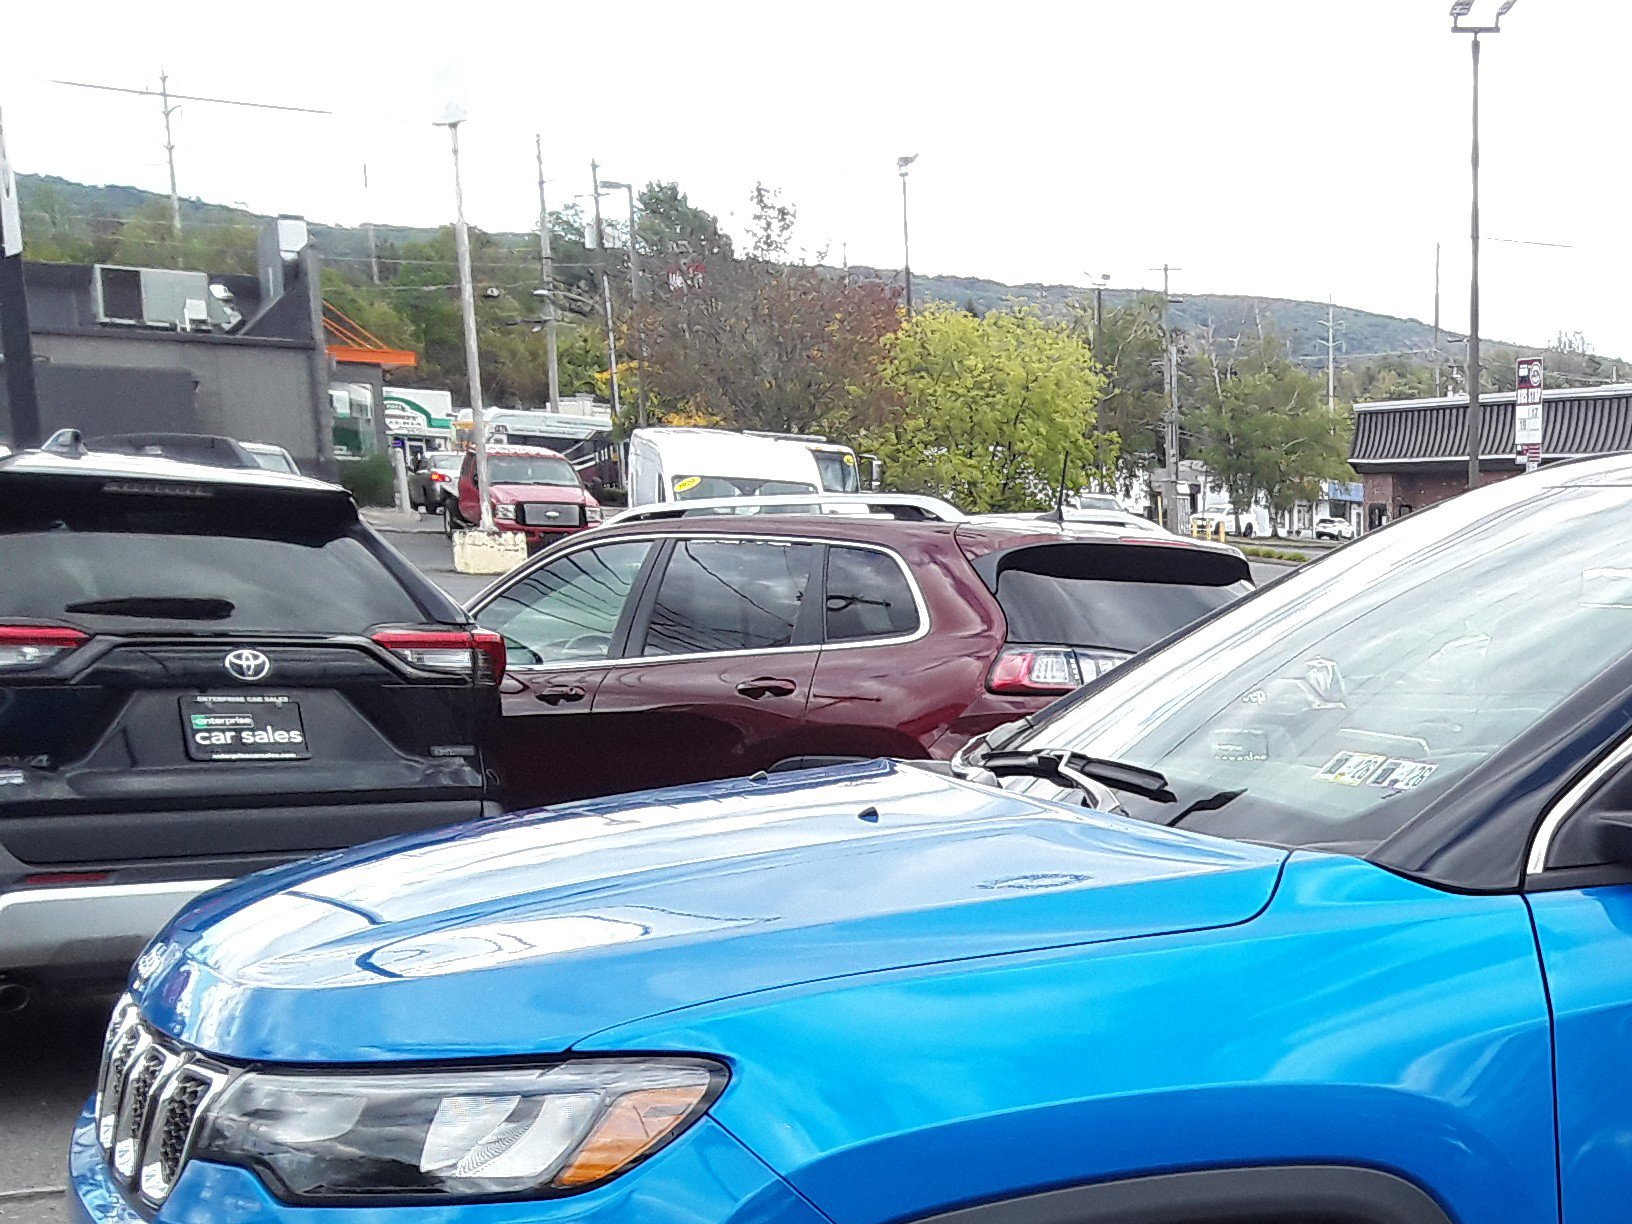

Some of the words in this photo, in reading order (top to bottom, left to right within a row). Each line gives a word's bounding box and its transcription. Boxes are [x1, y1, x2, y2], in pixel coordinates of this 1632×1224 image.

[193, 717, 252, 726] enterprise
[195, 731, 236, 745] car
[241, 725, 303, 743] sales
